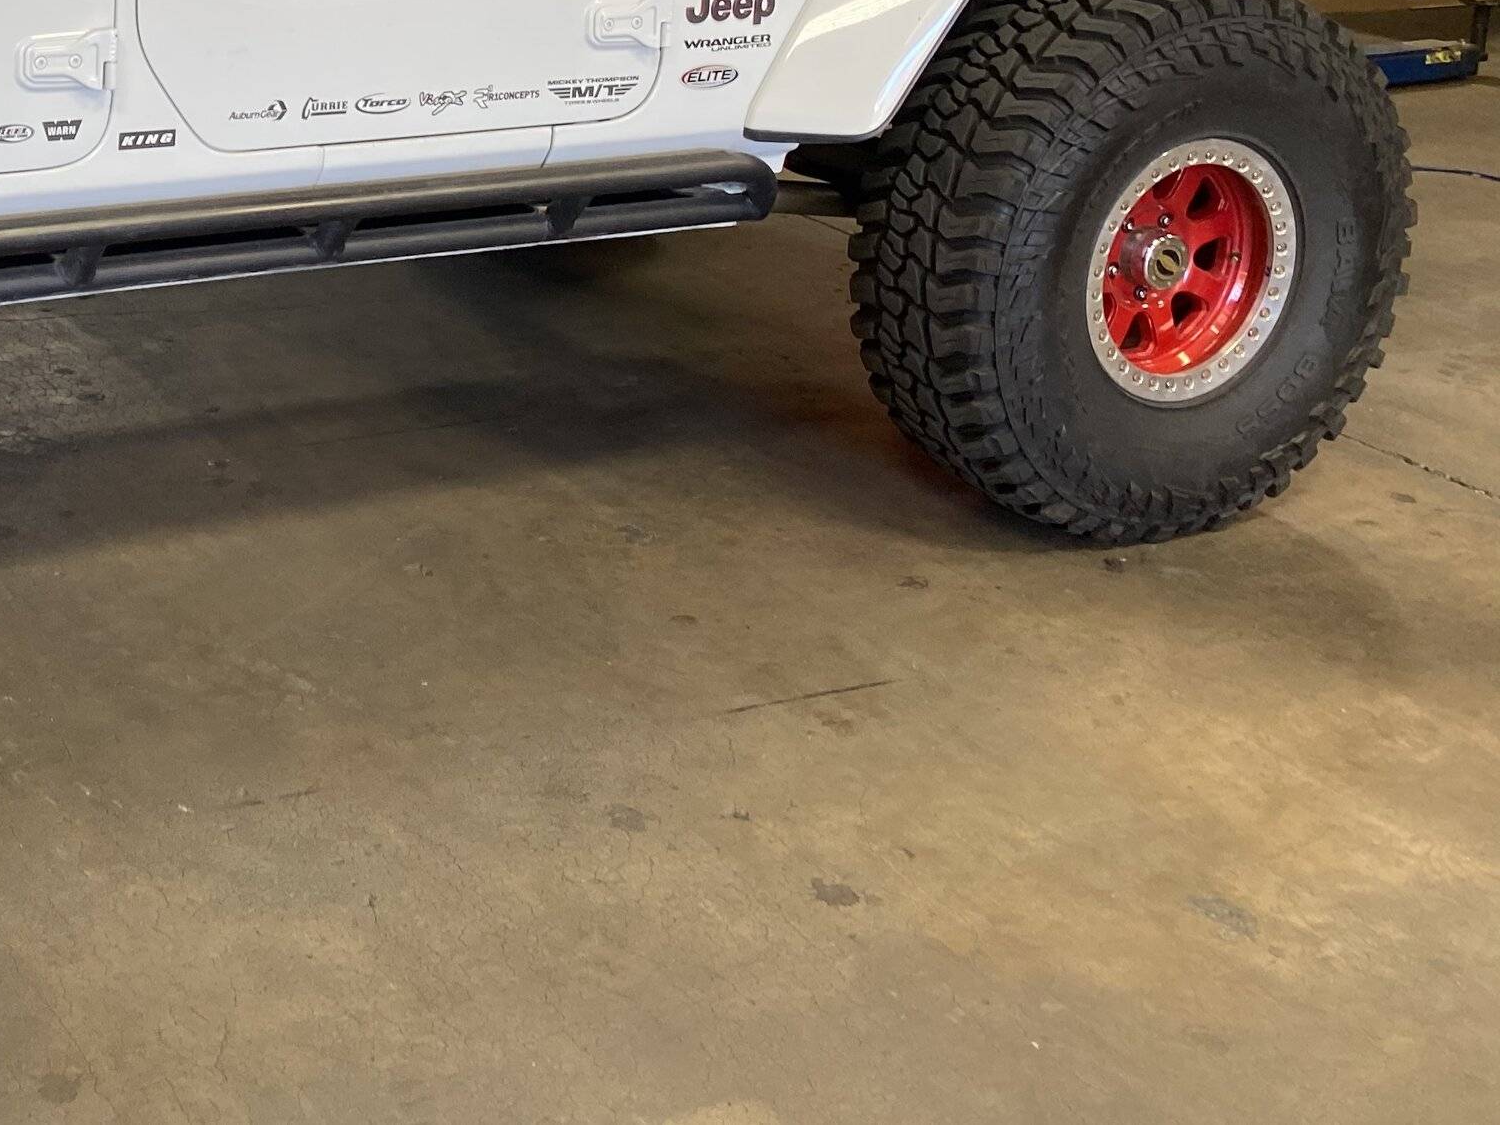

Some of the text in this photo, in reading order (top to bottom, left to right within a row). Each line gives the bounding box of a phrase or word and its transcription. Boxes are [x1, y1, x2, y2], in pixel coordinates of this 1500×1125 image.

[684, 33, 772, 49] WRANGLER
[711, 42, 772, 52] UNLIMITED
[547, 75, 640, 86] MICKEY THOMPSON
[687, 69, 733, 83] ELITE
[301, 96, 349, 121] CURRIE
[361, 97, 409, 109] Torco
[47, 125, 77, 136] WARN
[120, 132, 174, 147] KING
